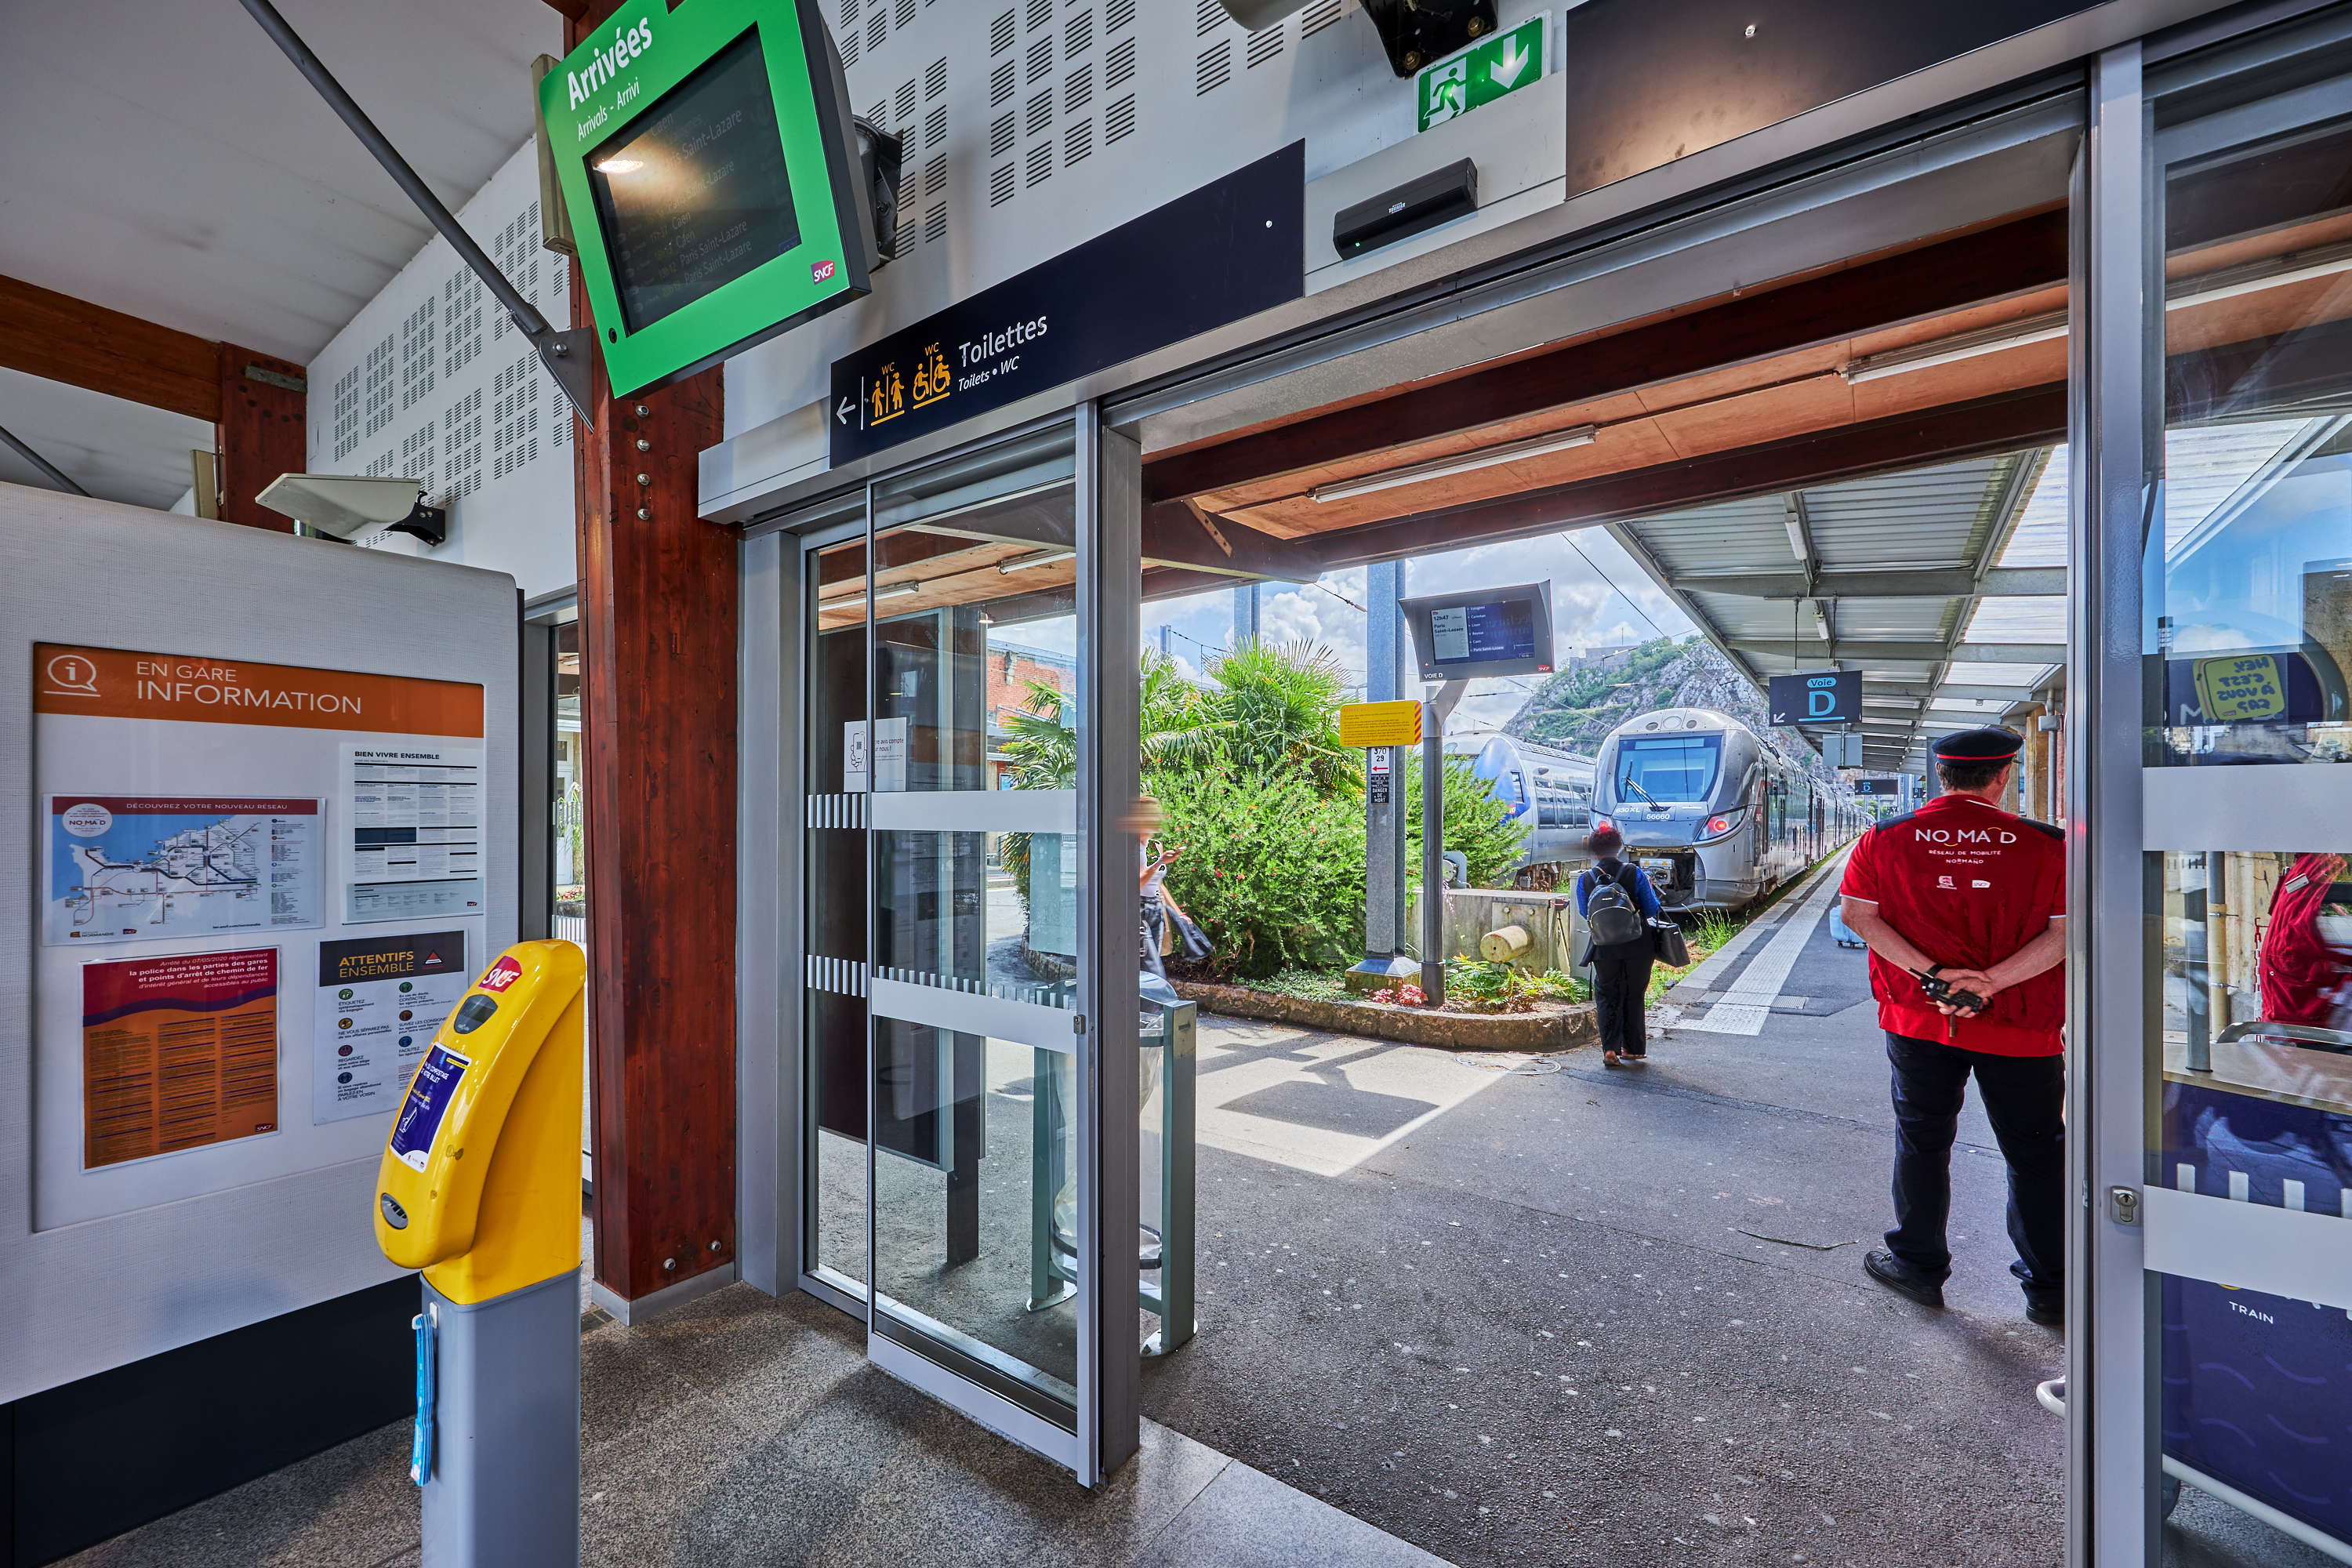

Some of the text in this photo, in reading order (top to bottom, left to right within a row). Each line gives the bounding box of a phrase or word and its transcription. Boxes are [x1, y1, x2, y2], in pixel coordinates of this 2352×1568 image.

[568, 17, 652, 111] Arrivées
[578, 77, 640, 141] Arrivals Arrivi
[682, 109, 742, 160] Saint-Lazare
[672, 212, 691, 230] Caen
[680, 248, 699, 267] Paris
[700, 220, 747, 259] Saint-Lazare
[684, 266, 703, 285] Paris
[704, 240, 752, 277] Saint-Lazare
[814, 263, 834, 282] SNCF
[925, 342, 939, 356] WC
[959, 315, 1047, 367] Toilettes
[882, 361, 895, 375] WC
[958, 355, 1020, 391] Toilets WC
[136, 662, 237, 682] EN GARE
[1811, 678, 1833, 687] Voie
[138, 680, 361, 714] INFORMATION
[1809, 690, 1836, 717] D
[229, 953, 268, 961] réglementant
[339, 951, 414, 967] ATTENTIFS
[140, 967, 165, 977] police
[203, 961, 229, 971] parties
[149, 974, 174, 983] points
[177, 971, 202, 979] d'arrêt
[339, 961, 414, 978] ENSEMBLE
[482, 967, 520, 988] SNCF
[168, 978, 191, 987] général
[227, 971, 268, 981] dépendances
[204, 980, 240, 989] accessibles
[2228, 1301, 2274, 1325] TRAIN
